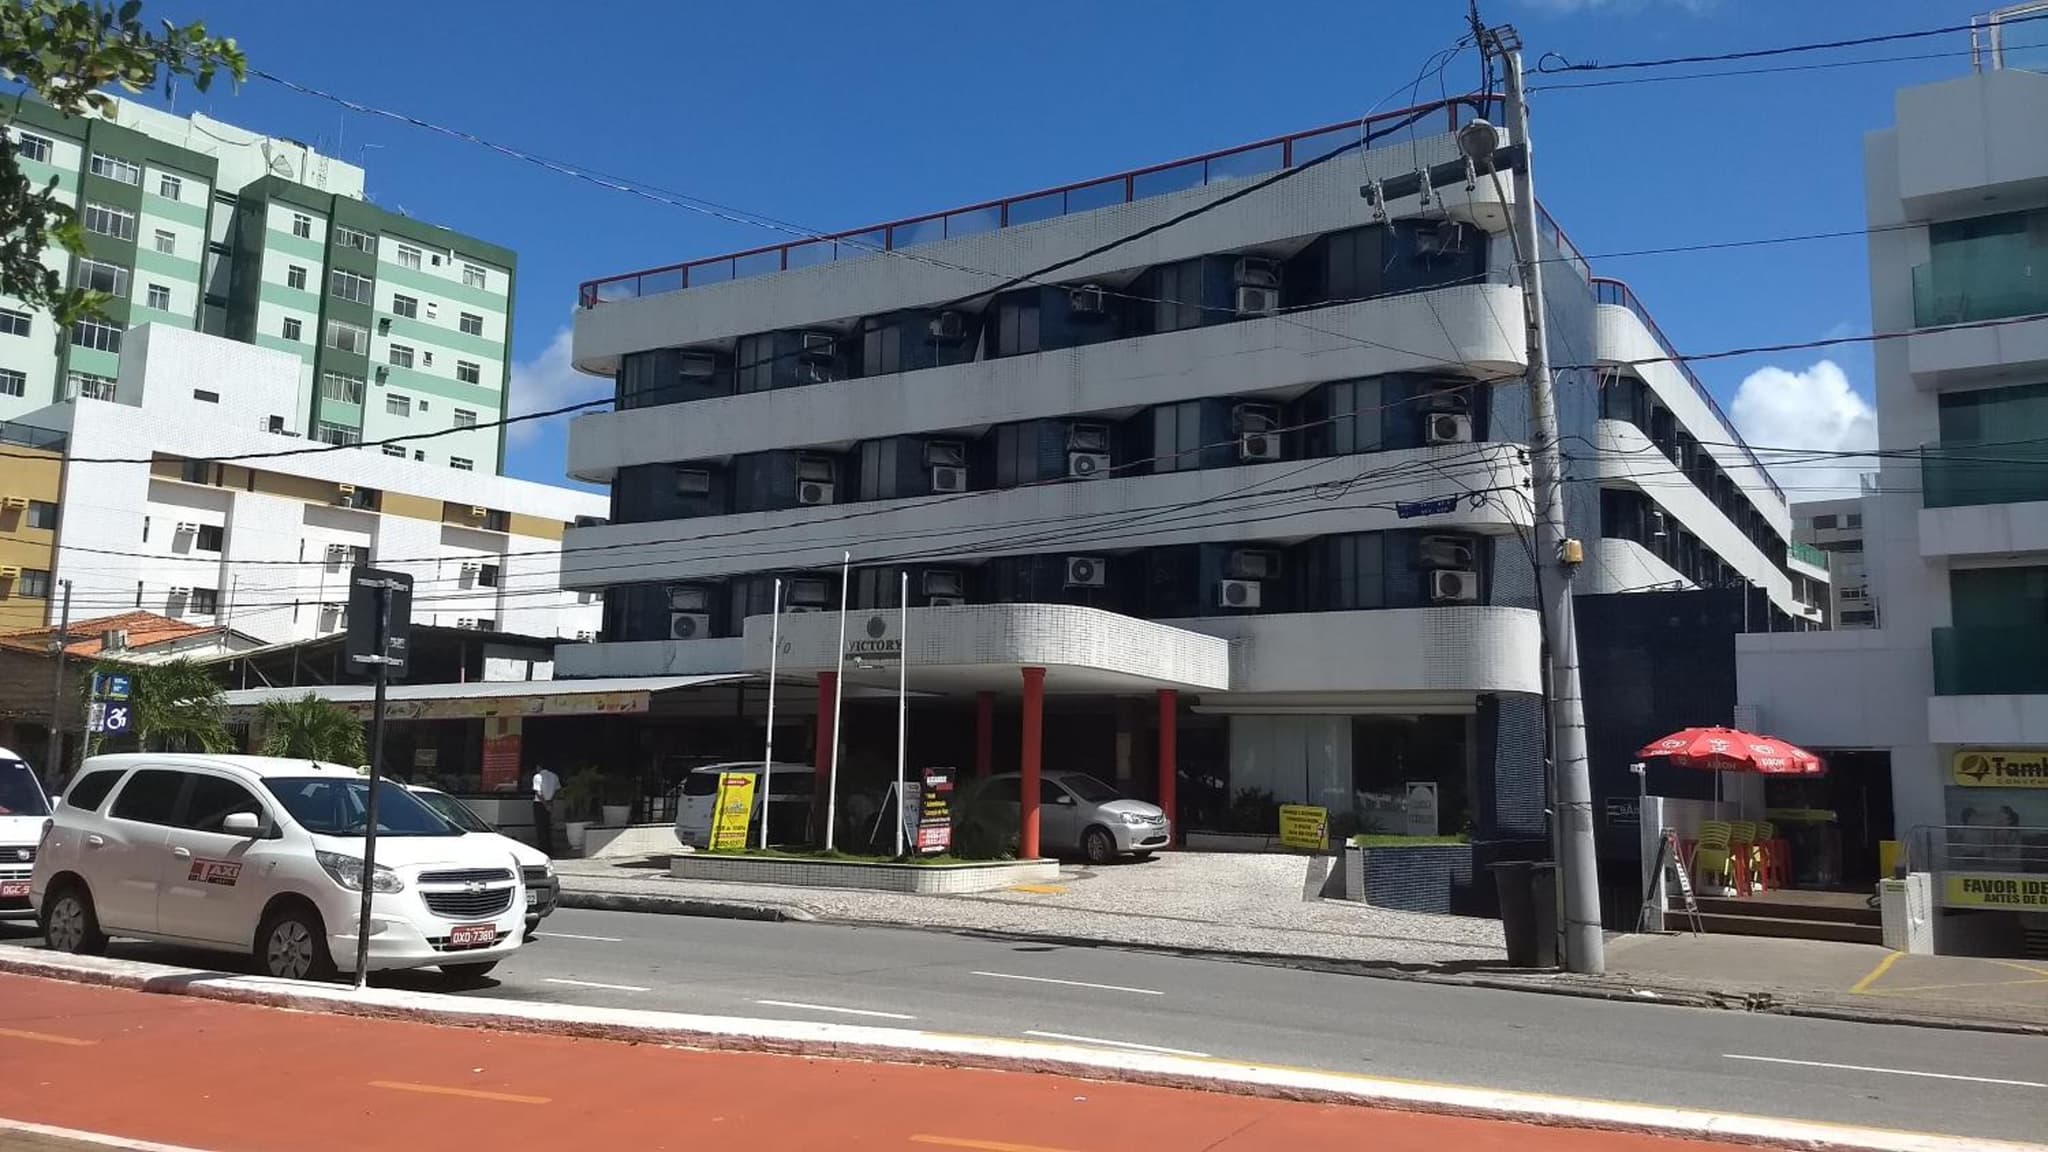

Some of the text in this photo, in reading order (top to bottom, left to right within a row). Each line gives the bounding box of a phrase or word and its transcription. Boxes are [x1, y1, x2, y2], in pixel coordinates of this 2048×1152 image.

[848, 640, 903, 652] VICTORY
[1963, 879, 2017, 893] FAVOR
[1984, 893, 2020, 904] ANTES
[2023, 895, 2037, 904] DE
